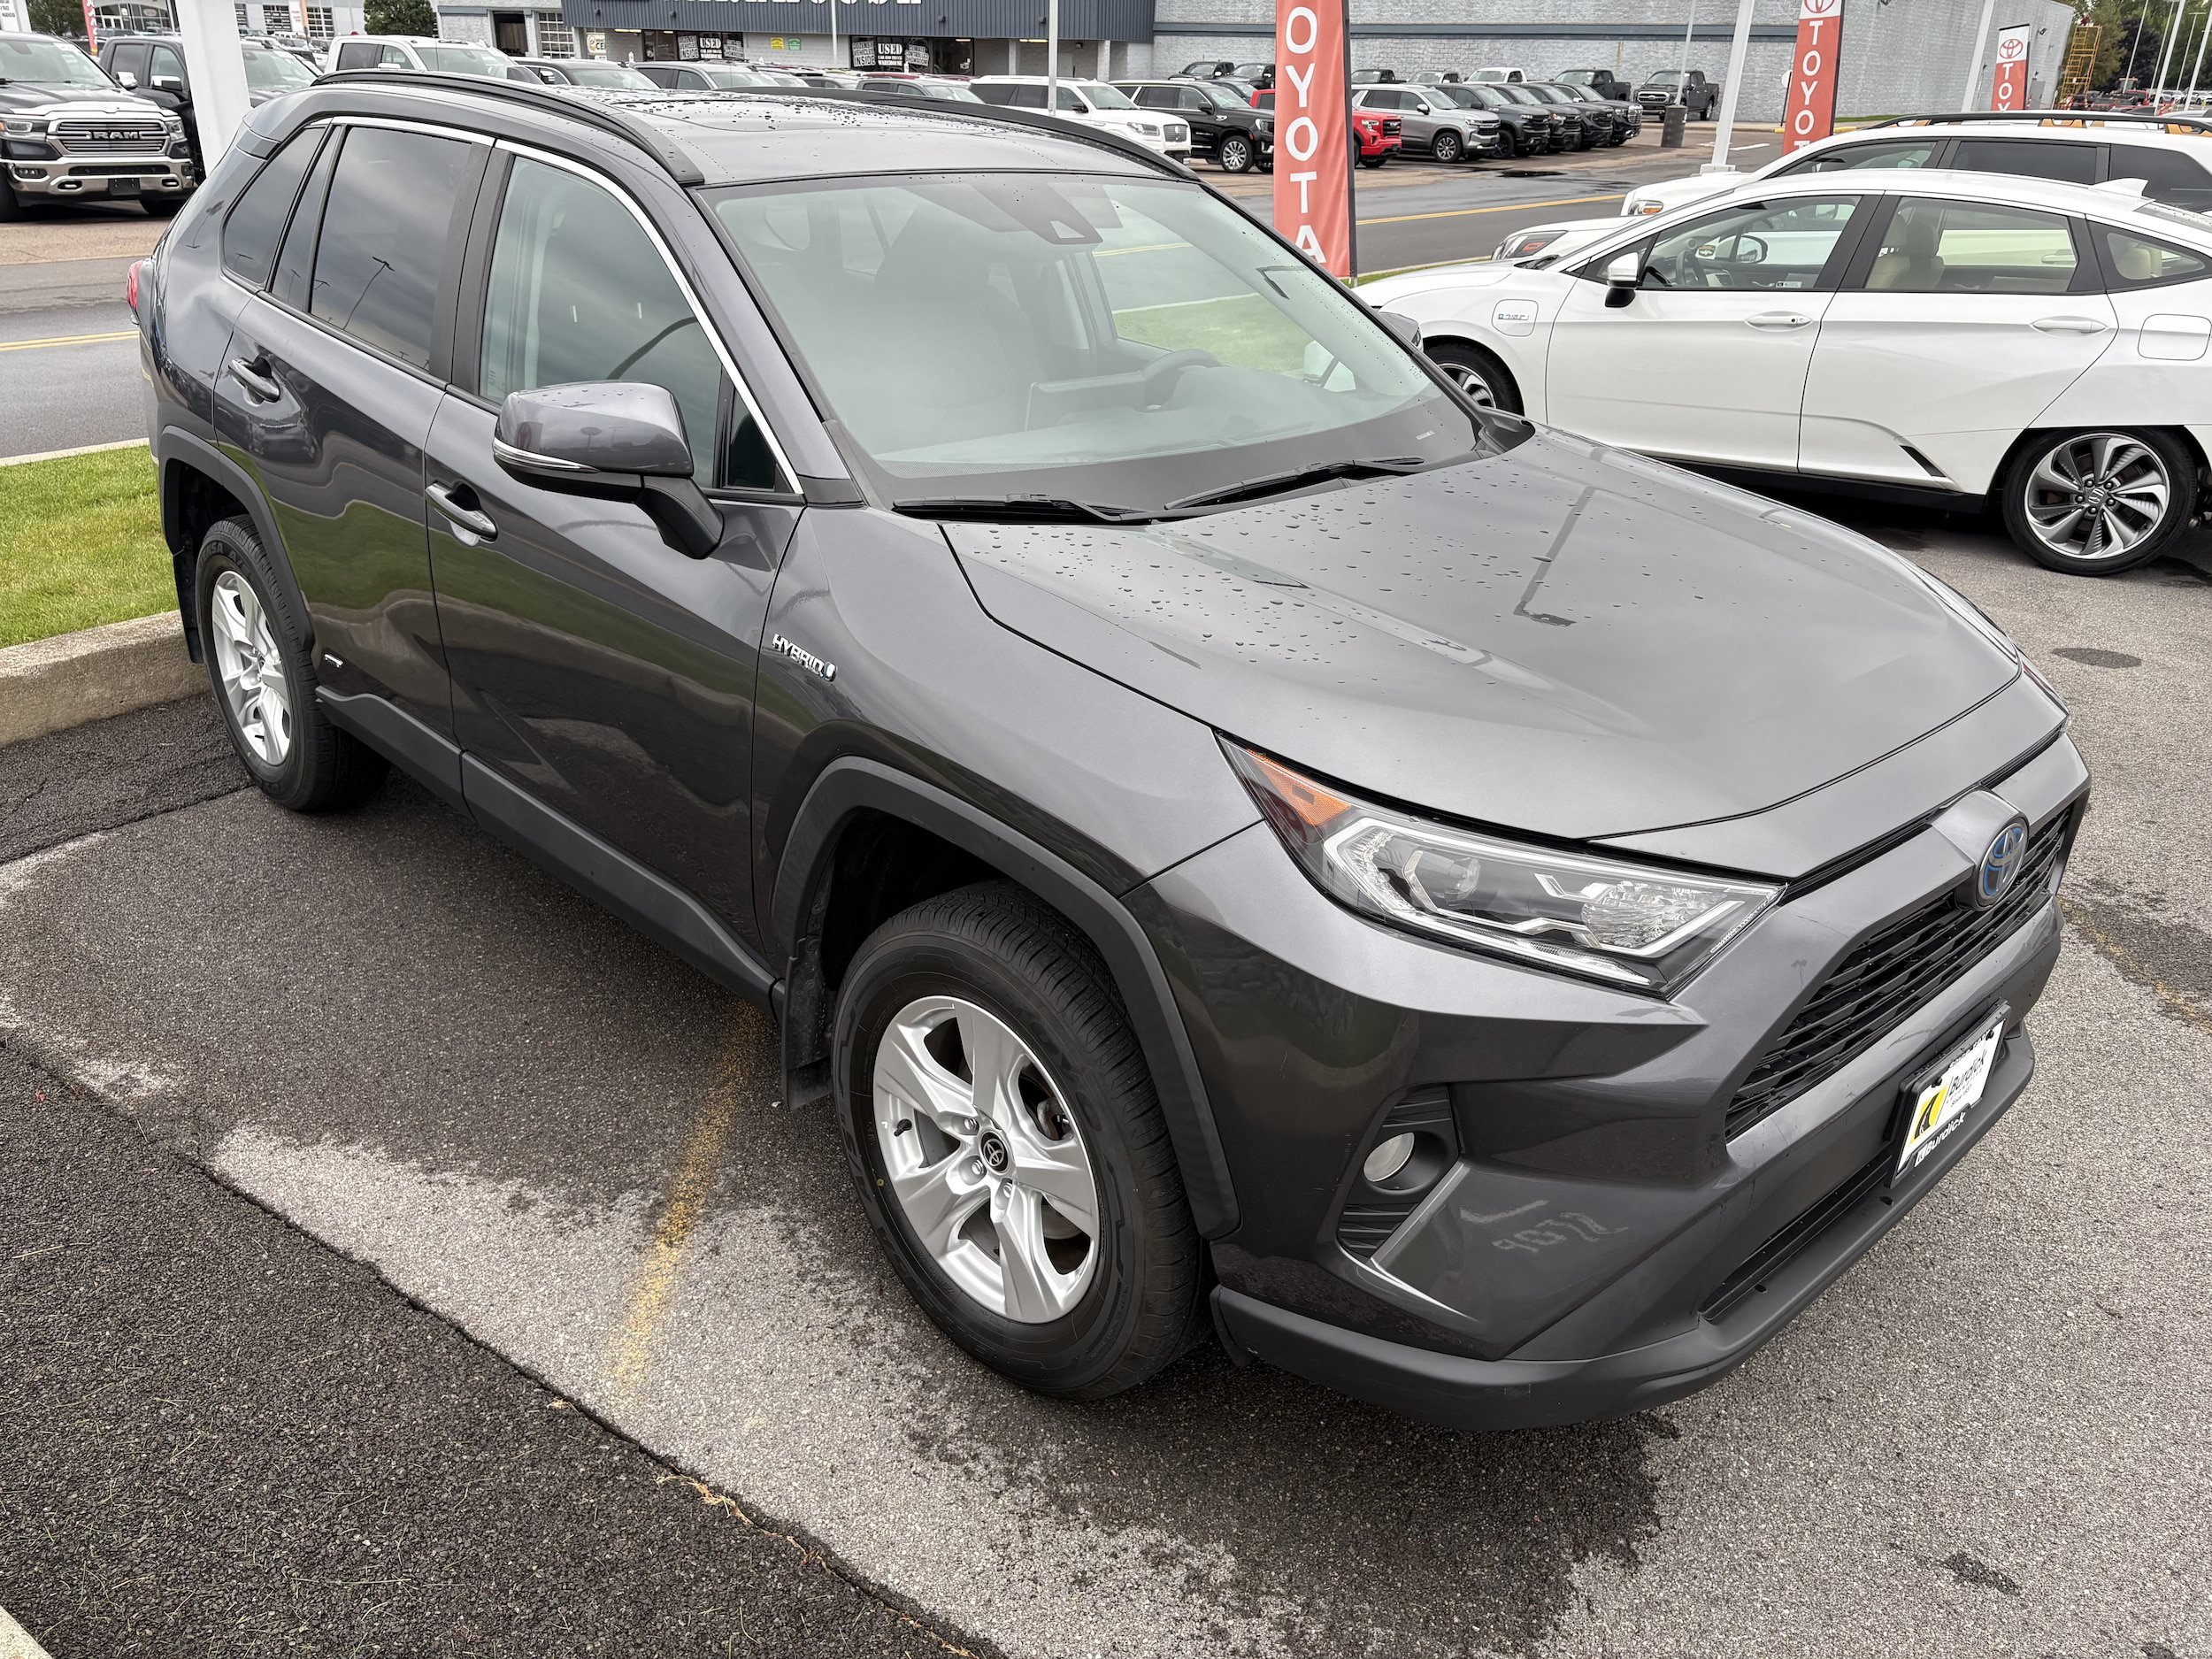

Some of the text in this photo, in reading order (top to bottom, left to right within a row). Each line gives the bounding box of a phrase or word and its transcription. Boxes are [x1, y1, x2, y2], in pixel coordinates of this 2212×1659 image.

[700, 38, 721, 49] USED
[878, 43, 902, 55] USED
[854, 55, 876, 67] INSIDE
[93, 131, 138, 140] RAM
[772, 634, 826, 677] HYBRID
[1948, 1048, 1987, 1096] Burdick
[1925, 1111, 1966, 1156] Burdick
